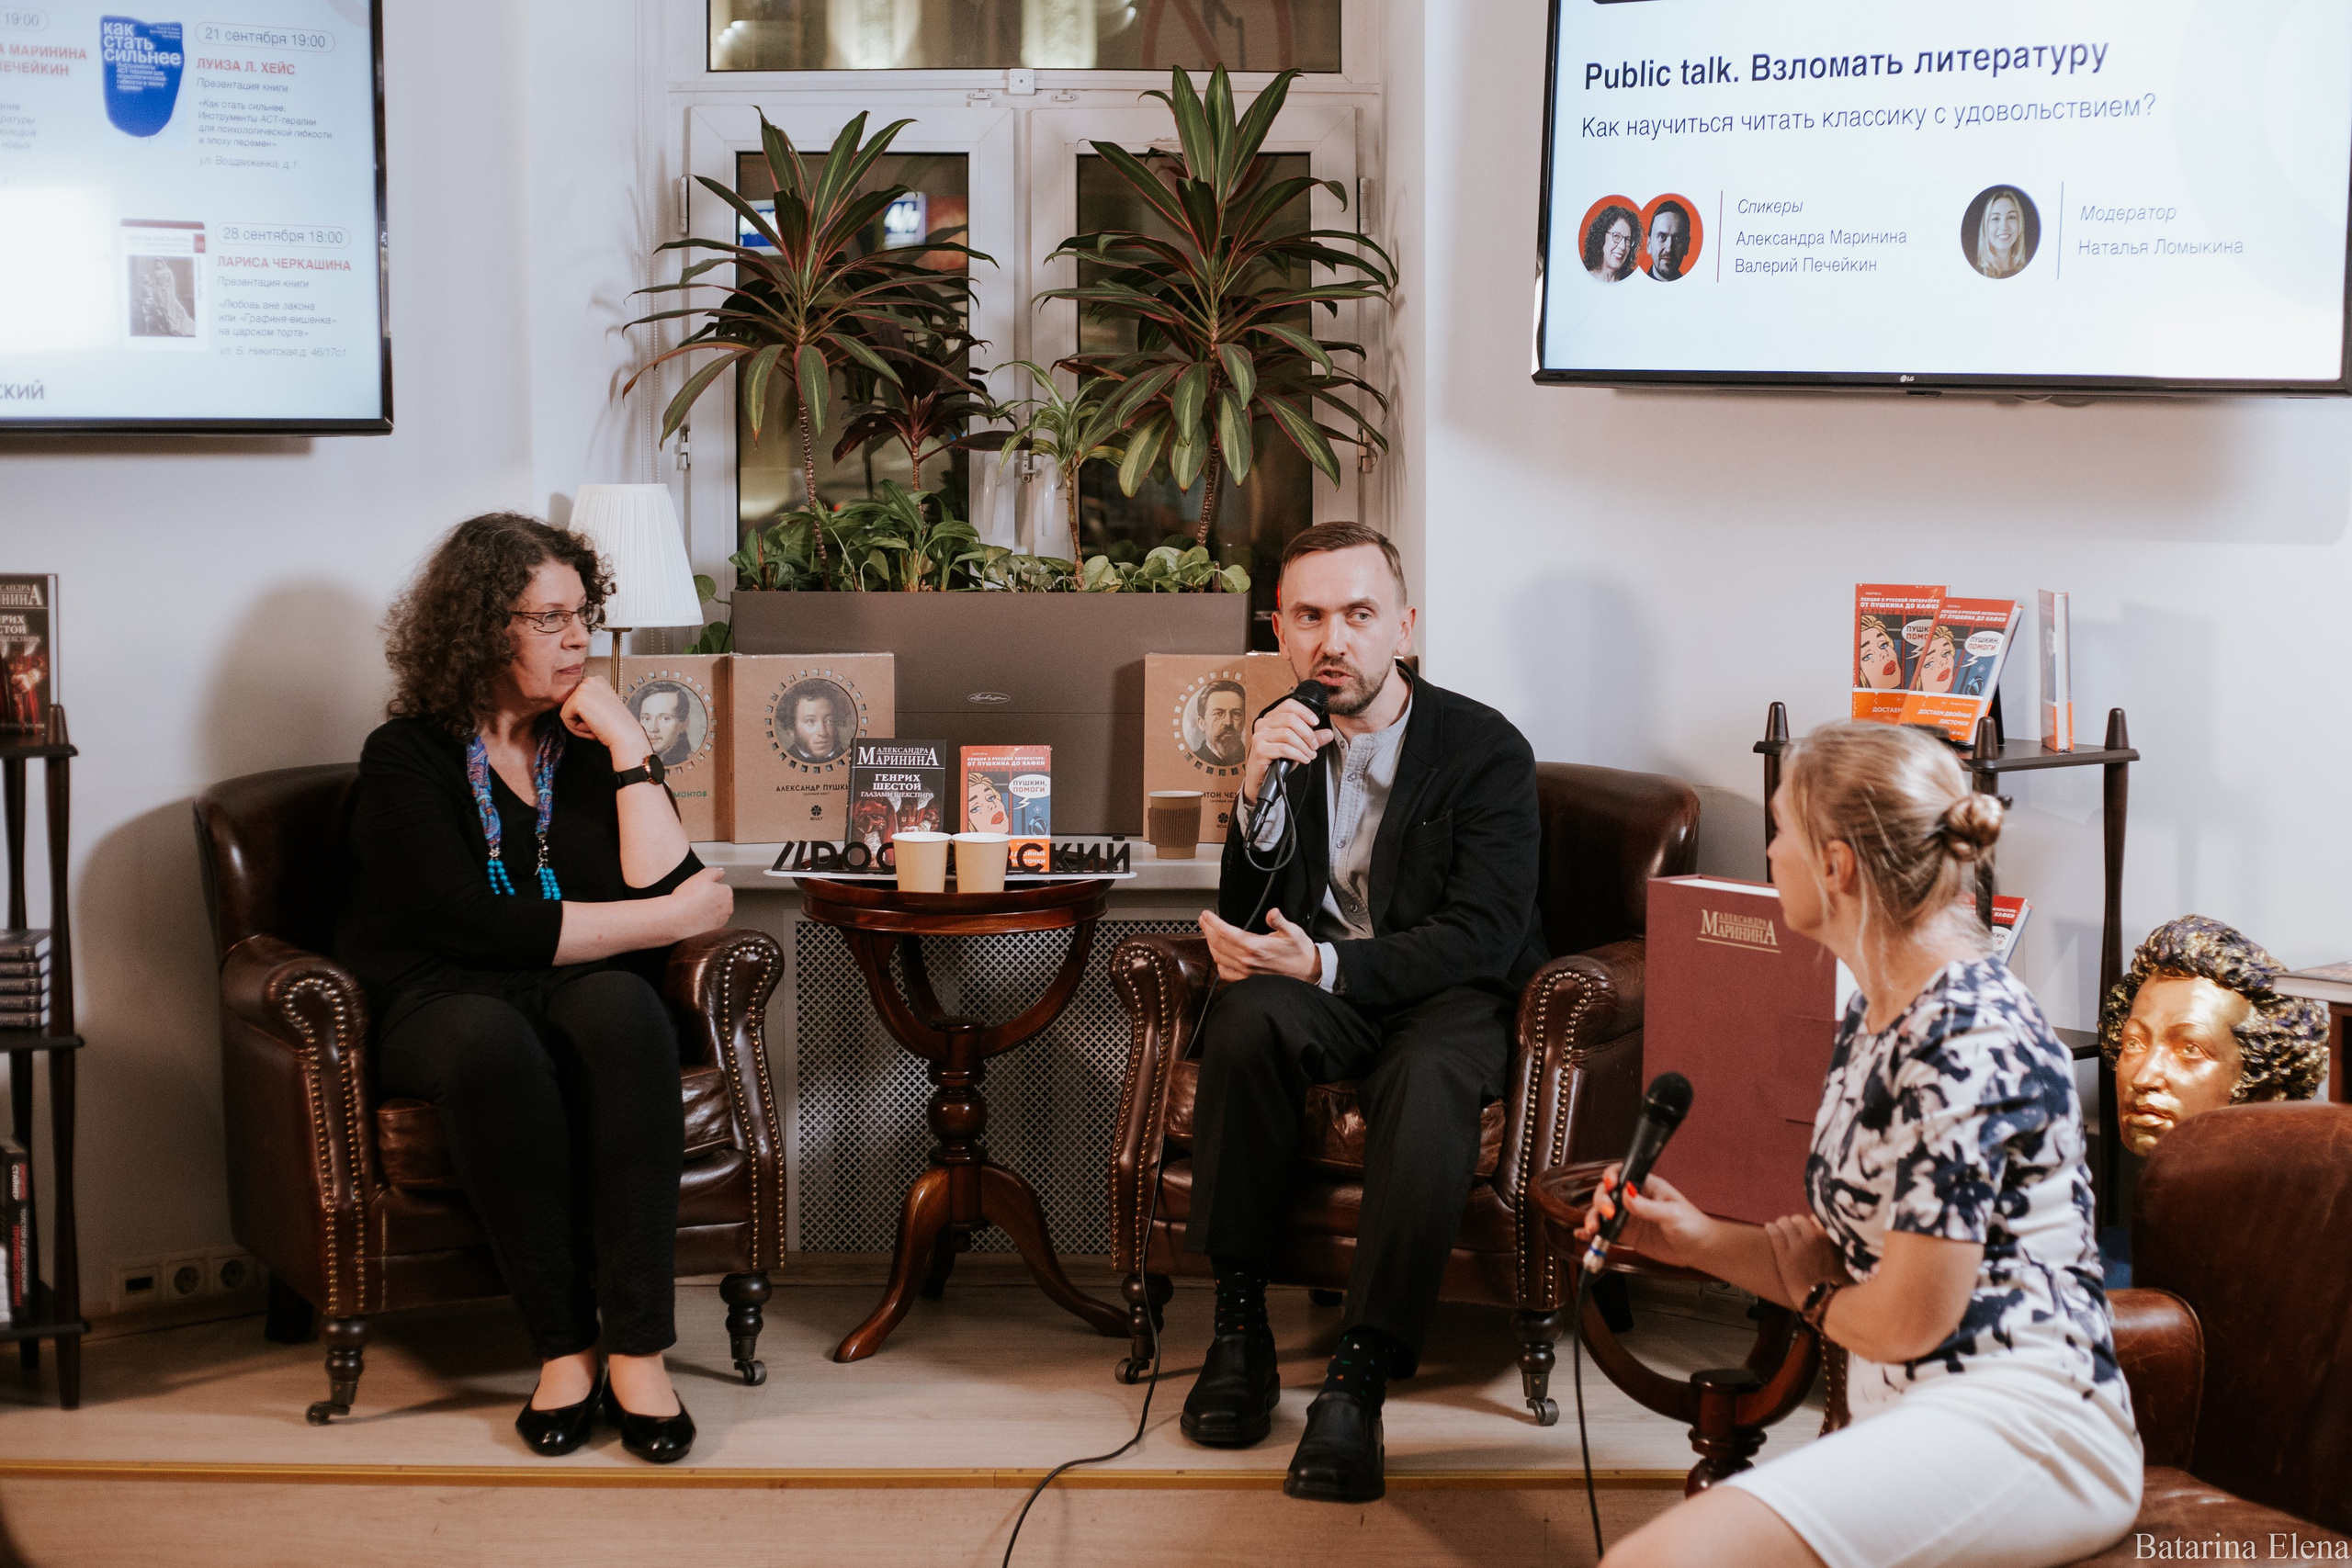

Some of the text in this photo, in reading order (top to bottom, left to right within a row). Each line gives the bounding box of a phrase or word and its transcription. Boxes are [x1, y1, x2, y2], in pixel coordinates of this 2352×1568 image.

[5, 12, 40, 26] 19:00
[103, 22, 135, 36] как
[205, 27, 325, 47] 21 сентября 19:00
[103, 35, 153, 51] стать
[9, 43, 87, 60] МАРИНИНА
[103, 49, 181, 65] сильнее
[197, 58, 295, 74] ЛУИЗА Л. ХЕЙС
[1585, 41, 2109, 90] Public talk. Взломать литературу
[197, 77, 288, 92] Презентация книги
[248, 103, 286, 112] сильнее.
[198, 111, 257, 121] Инструменты
[1582, 92, 2156, 141] Как научиться читать классику с удовольствием?
[217, 126, 292, 136] психологической
[294, 130, 332, 138] гибкости
[207, 139, 230, 147] эпоху
[1737, 198, 1804, 217] Спикеры
[2080, 205, 2177, 223] Модератор
[223, 227, 343, 244] 28 сентября 18:00
[1736, 230, 1907, 248] Александра Маринина
[2079, 238, 2244, 254] Наталья Ломыкина
[217, 255, 351, 271] ЛАРИСА ЧЕРКАШИНА
[1735, 256, 1877, 276] Валерий Печейкин
[218, 276, 310, 288] Презентация книги
[282, 302, 315, 311] закона
[218, 314, 236, 322] или
[232, 329, 274, 338] царском
[248, 346, 297, 356] Никитская
[0, 379, 44, 400] КИЙ
[1, 584, 42, 605] НИНА
[0, 615, 25, 624] РИХ
[857, 747, 939, 766] МАРИНИНА
[875, 773, 921, 782] ГЕНРИХ
[873, 782, 922, 791] ШЕСТОЙ
[1701, 909, 1778, 946] МАРИНИНА
